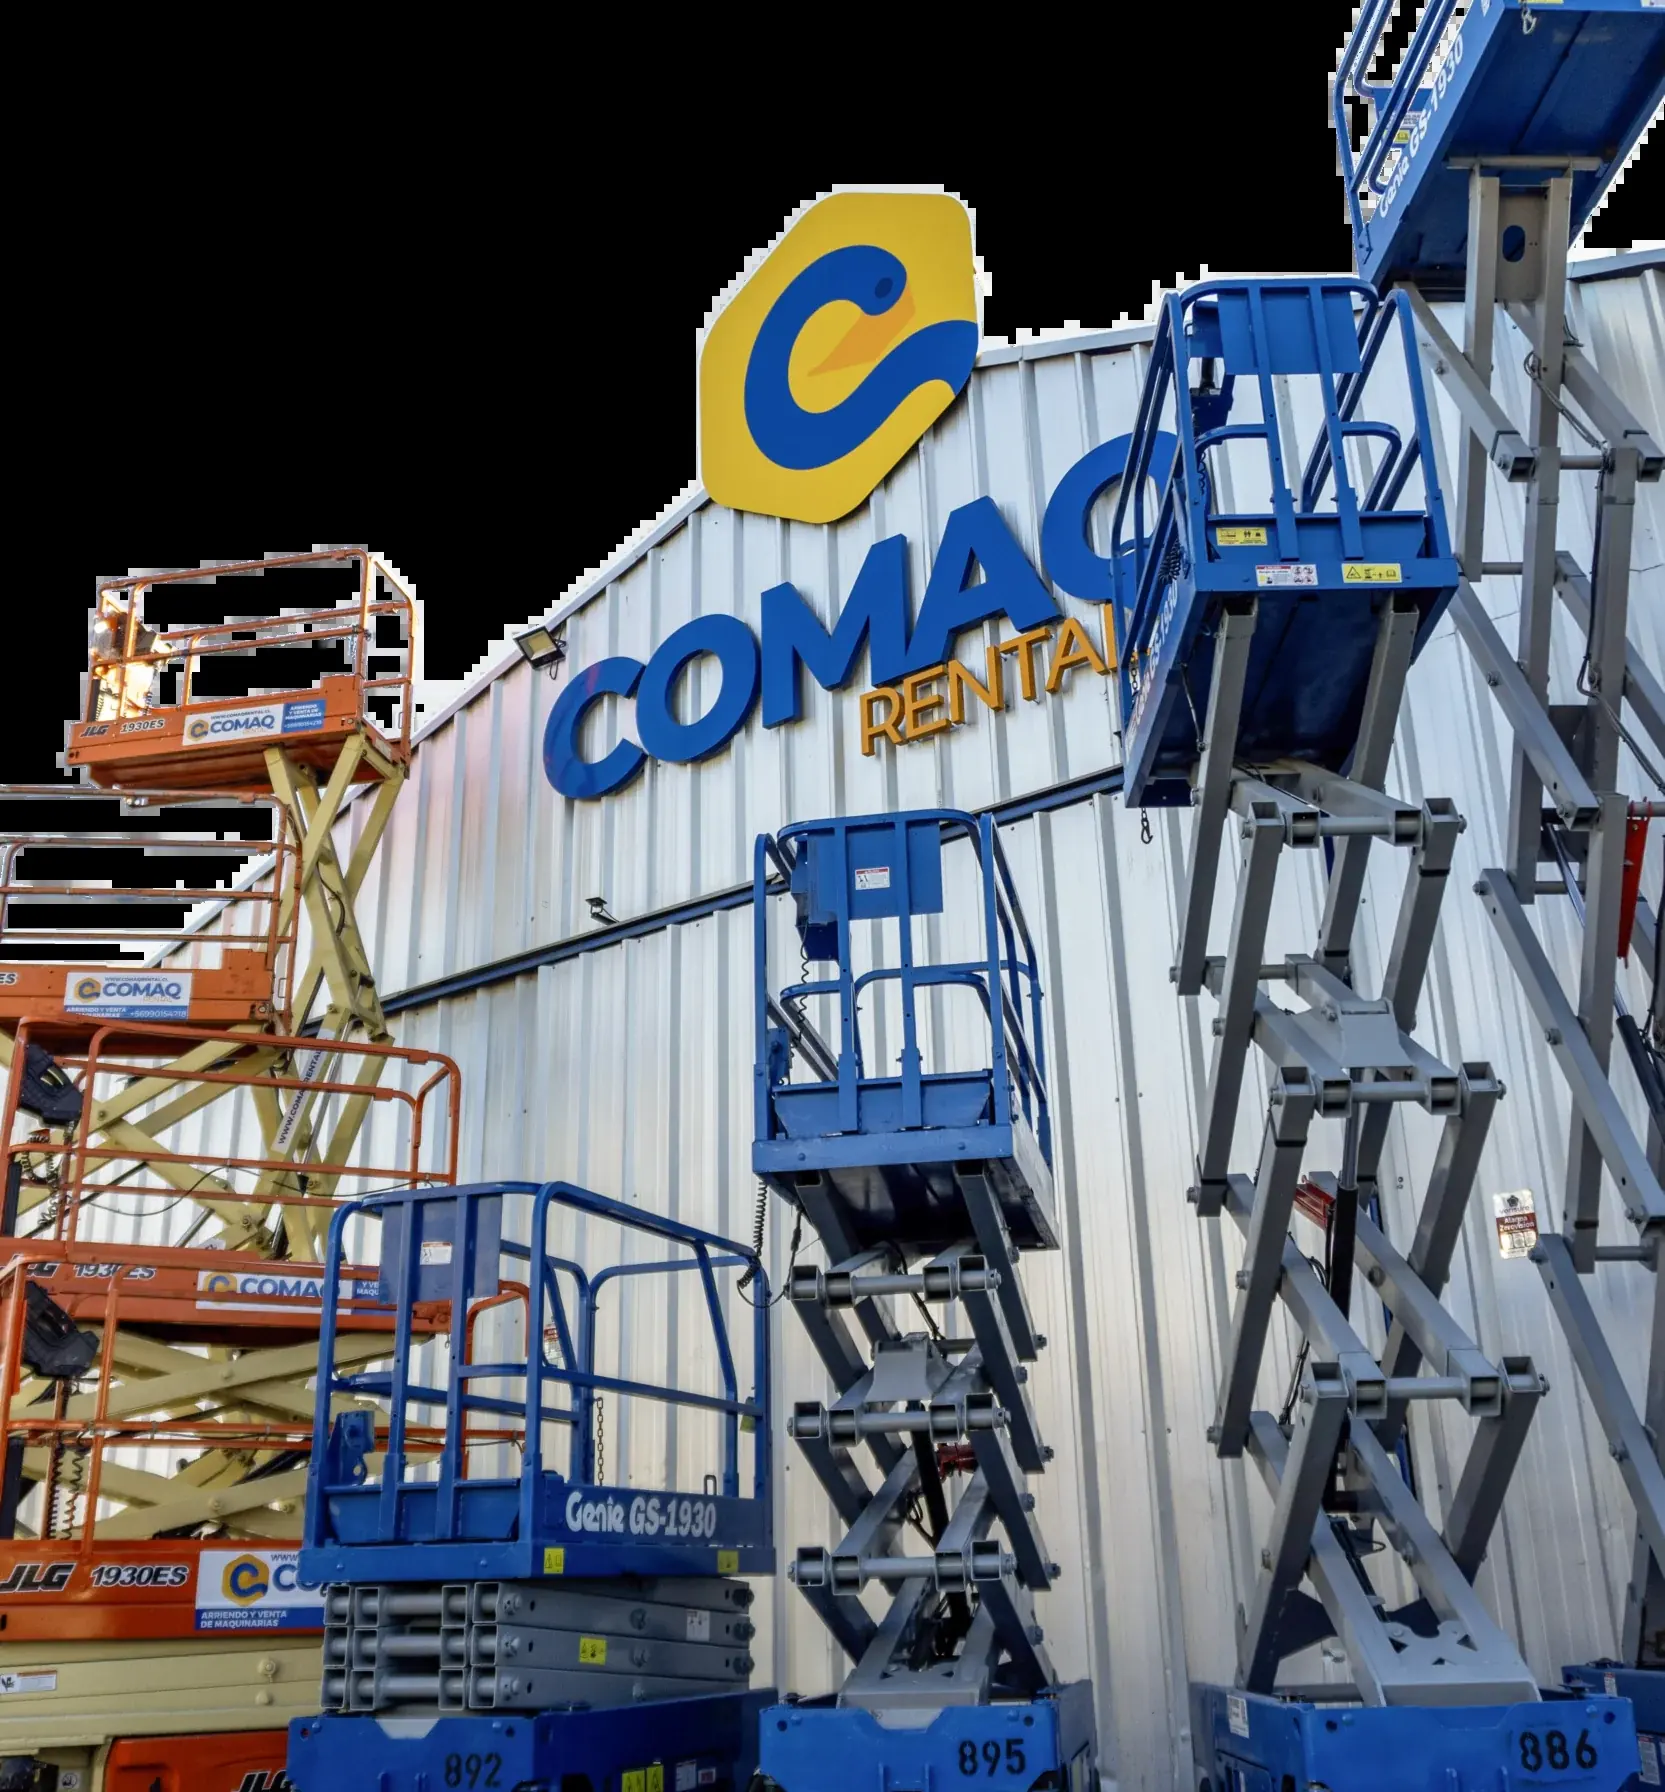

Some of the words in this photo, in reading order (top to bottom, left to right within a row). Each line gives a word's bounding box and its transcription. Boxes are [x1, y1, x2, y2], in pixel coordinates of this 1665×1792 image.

[81, 724, 110, 738] JLG
[120, 718, 165, 734] 1930ES
[210, 714, 275, 733] COMAQ
[102, 982, 182, 999] COMAQ
[240, 1277, 340, 1298] COMA
[566, 1489, 625, 1533] Genie
[629, 1496, 717, 1539] GS-1930
[0, 1562, 77, 1593] JLG
[91, 1565, 190, 1588] 1930ES
[200, 1620, 213, 1629] DE
[214, 1619, 279, 1629] MAQUINARIAS
[201, 1611, 249, 1620] ARRIENDO
[250, 1611, 257, 1619] Y
[258, 1610, 287, 1619] VENTA
[959, 1738, 1026, 1778] 895
[1519, 1728, 1598, 1773] 886
[443, 1752, 503, 1789] 892
